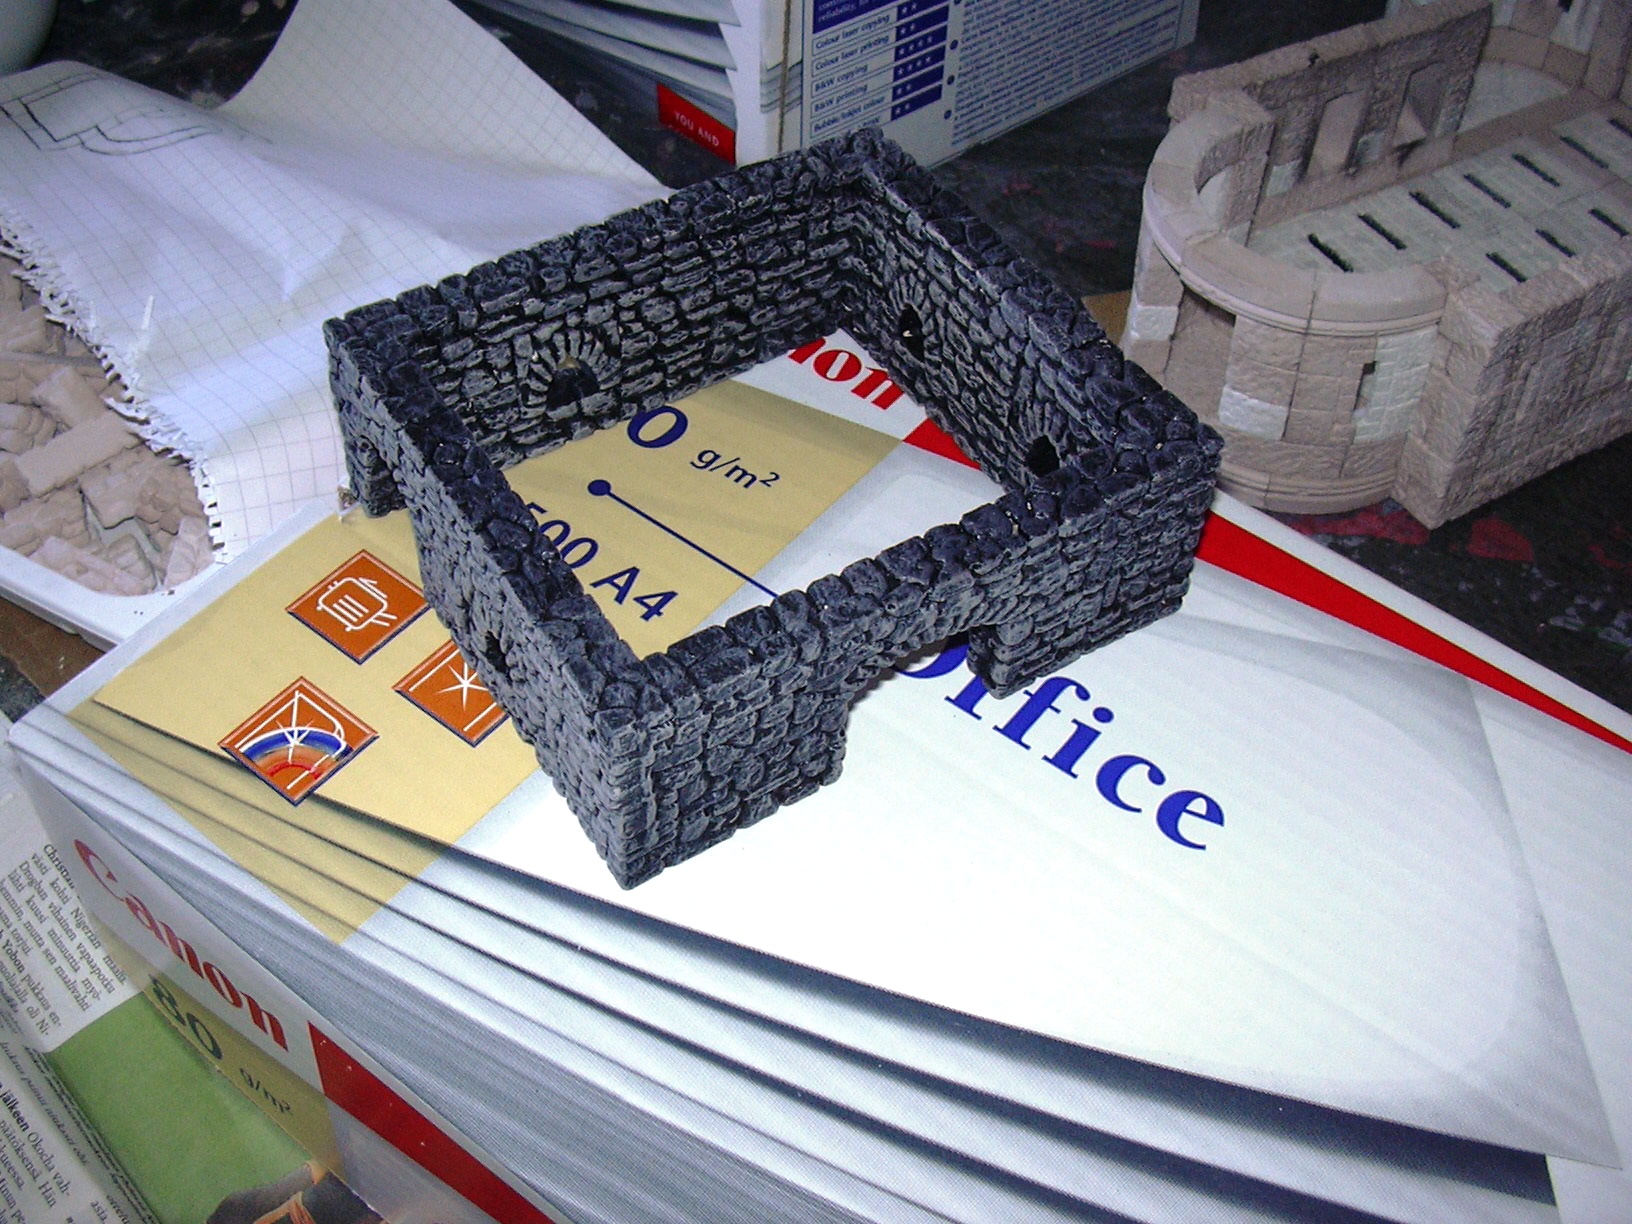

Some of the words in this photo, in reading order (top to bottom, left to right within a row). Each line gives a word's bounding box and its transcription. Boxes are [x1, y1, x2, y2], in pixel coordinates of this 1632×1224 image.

[815, 35, 840, 50] Colour
[861, 14, 890, 31] copying
[815, 56, 840, 71] Colour
[860, 35, 889, 53] printing
[836, 84, 868, 103] printing
[837, 65, 868, 82] copying
[674, 110, 694, 131] YOU
[698, 126, 719, 146] AND
[590, 566, 678, 622] A4
[19, 860, 48, 901] Drogban
[48, 902, 77, 941] vihainen
[76, 942, 115, 994] vapaapotku
[26, 895, 48, 924] kuusi
[47, 928, 81, 973] minuuttia
[50, 877, 72, 905] kohti
[70, 906, 101, 949] Nigerian
[2, 939, 25, 974] Yobon
[21, 973, 51, 1011] pukkaus
[23, 921, 45, 948] mutta
[42, 947, 57, 966] sen
[55, 965, 91, 1011] maalivahti
[74, 839, 289, 1052] Canon
[26, 1006, 40, 1019] oli
[148, 973, 223, 1060] 80
[0, 1088, 30, 1132] jälkeen
[27, 1131, 55, 1172] Okocha
[39, 1181, 57, 1208] Hän
